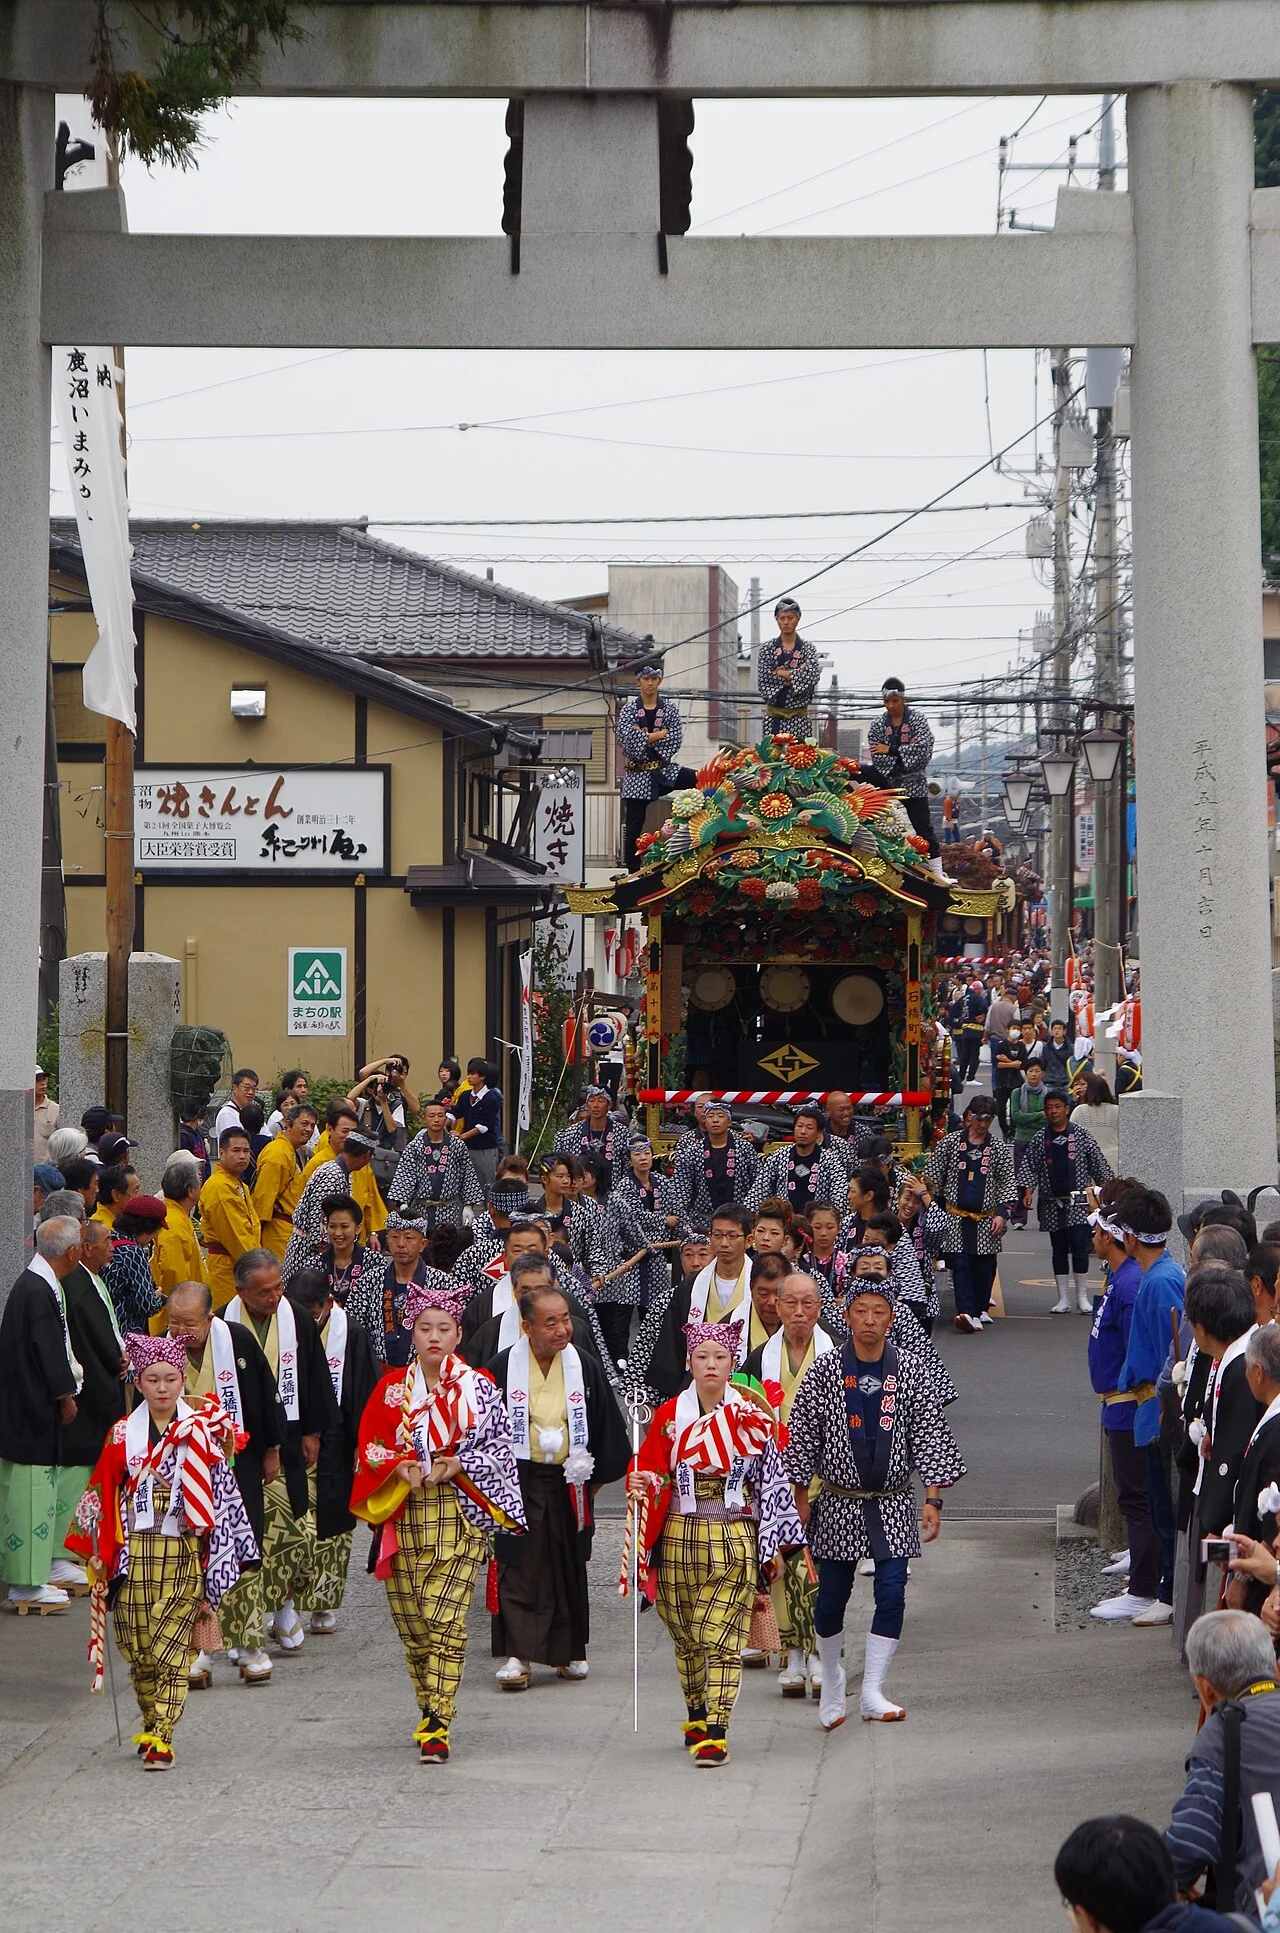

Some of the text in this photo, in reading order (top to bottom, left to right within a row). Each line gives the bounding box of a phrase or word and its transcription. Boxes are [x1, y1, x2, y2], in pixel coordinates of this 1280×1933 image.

[156, 775, 293, 820] 焼きんとん
[296, 814, 356, 825] 創業明治三十二年
[1192, 739, 1218, 939] 平成五年十月吉日
[143, 842, 233, 857] 大臣栄誉賞受賞
[259, 822, 367, 862] 紀州屋
[292, 1006, 342, 1018] まちの駅
[649, 981, 659, 1024] 第十番
[907, 990, 919, 1034] 石橋町
[281, 1367, 295, 1406] 石橋町
[844, 1375, 862, 1428] 総務
[880, 1374, 897, 1432] 石橋町
[511, 1406, 526, 1445] 石橋町
[572, 1406, 587, 1446] 石橋町
[678, 1460, 691, 1497] 石橋町
[727, 1455, 745, 1491] 石橋町
[135, 1478, 149, 1514] 橋町
[169, 1478, 184, 1519] 橋町
